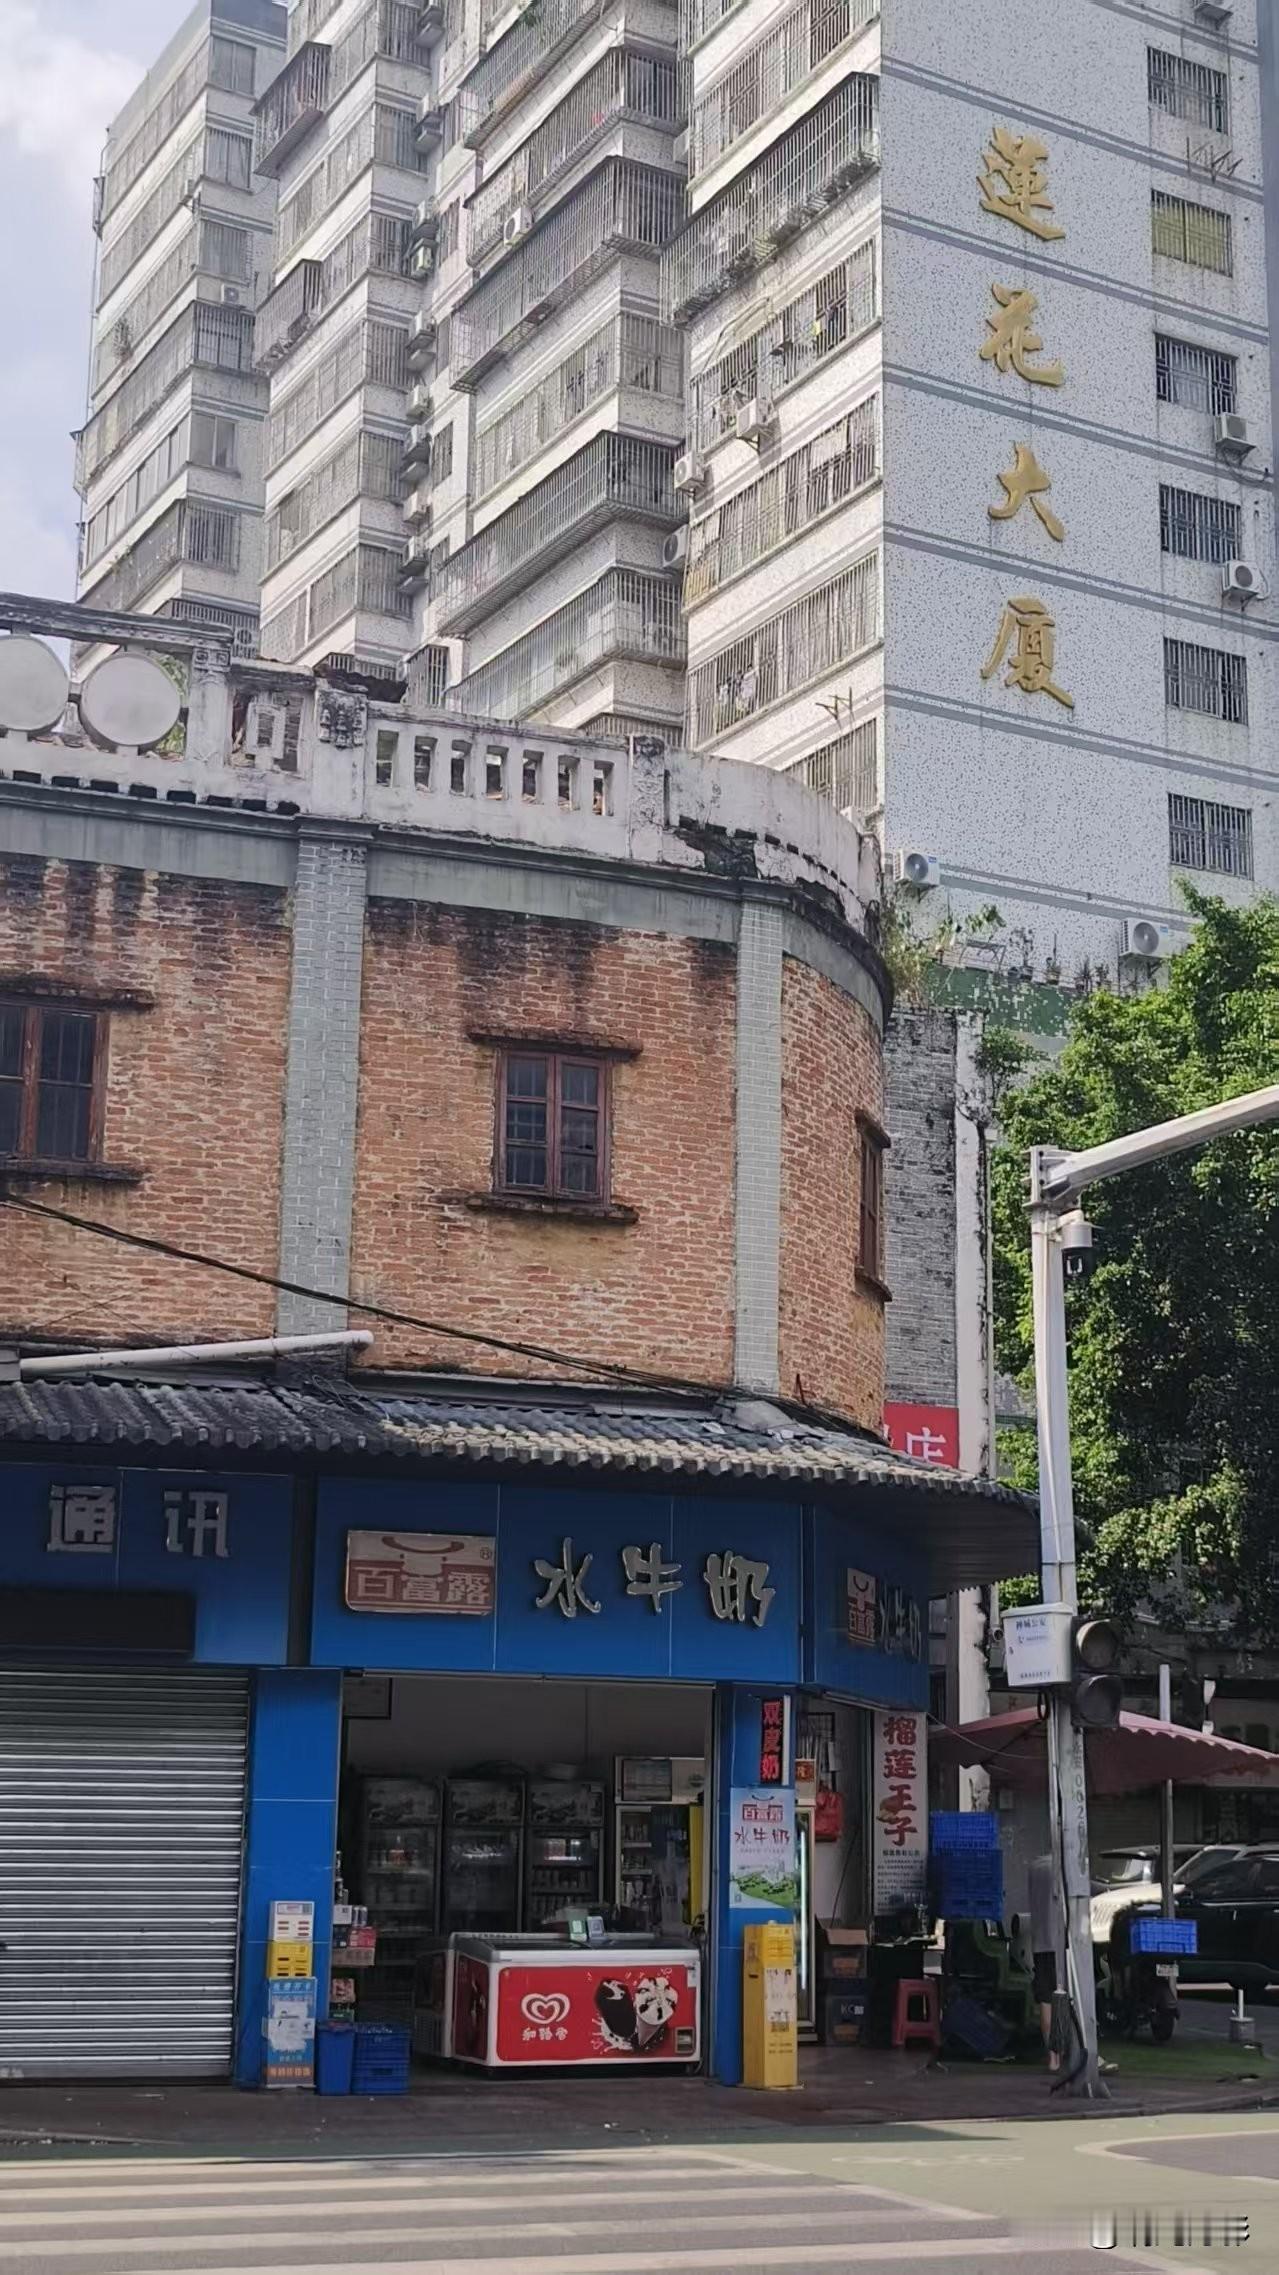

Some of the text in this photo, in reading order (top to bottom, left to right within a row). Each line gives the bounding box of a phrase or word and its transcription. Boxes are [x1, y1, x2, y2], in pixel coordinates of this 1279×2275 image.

[47, 1484, 230, 1557] 通讯
[354, 1566, 490, 1604] 百富露
[534, 1537, 776, 1627] 水牛奶
[883, 1716, 917, 1846] 榴莲王子
[734, 1826, 790, 1845] 水牛奶
